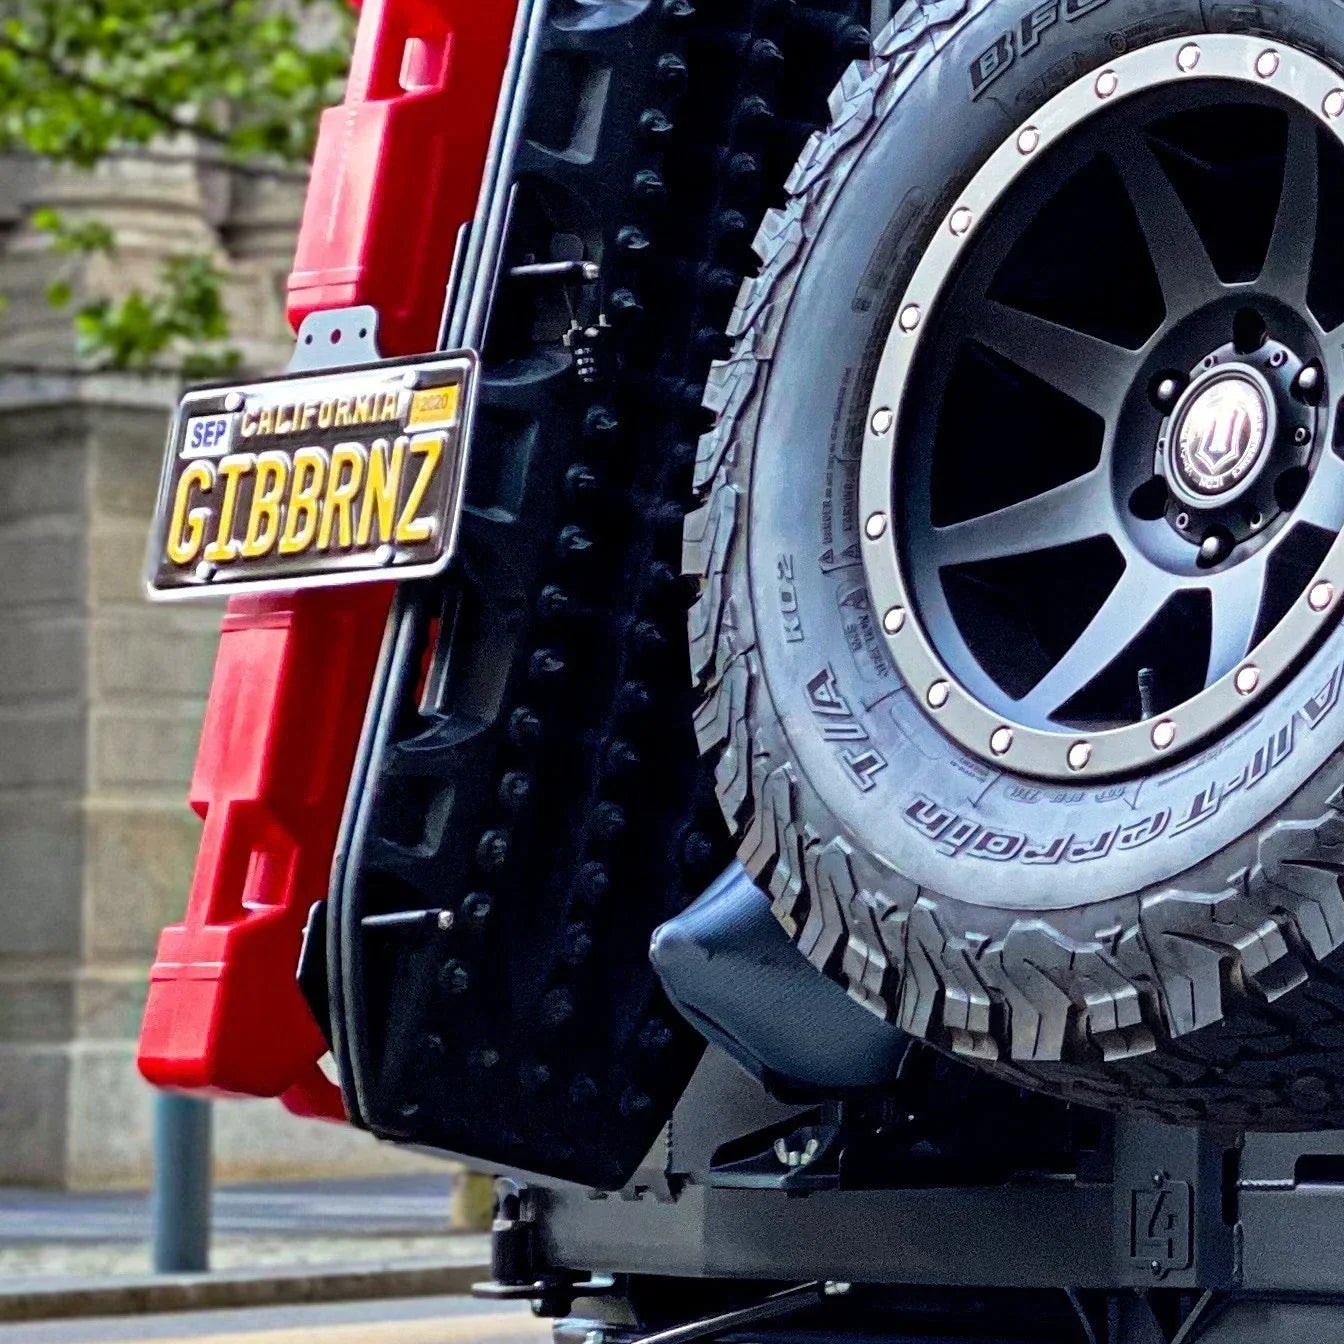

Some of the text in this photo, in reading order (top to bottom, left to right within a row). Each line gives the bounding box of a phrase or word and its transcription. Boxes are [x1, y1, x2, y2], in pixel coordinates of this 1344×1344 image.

[189, 421, 228, 449] SEP
[240, 393, 400, 438] CALIFORNIA
[166, 430, 449, 566] GIBBRNZ
[777, 552, 804, 644] KO2
[802, 660, 889, 794] T/A
